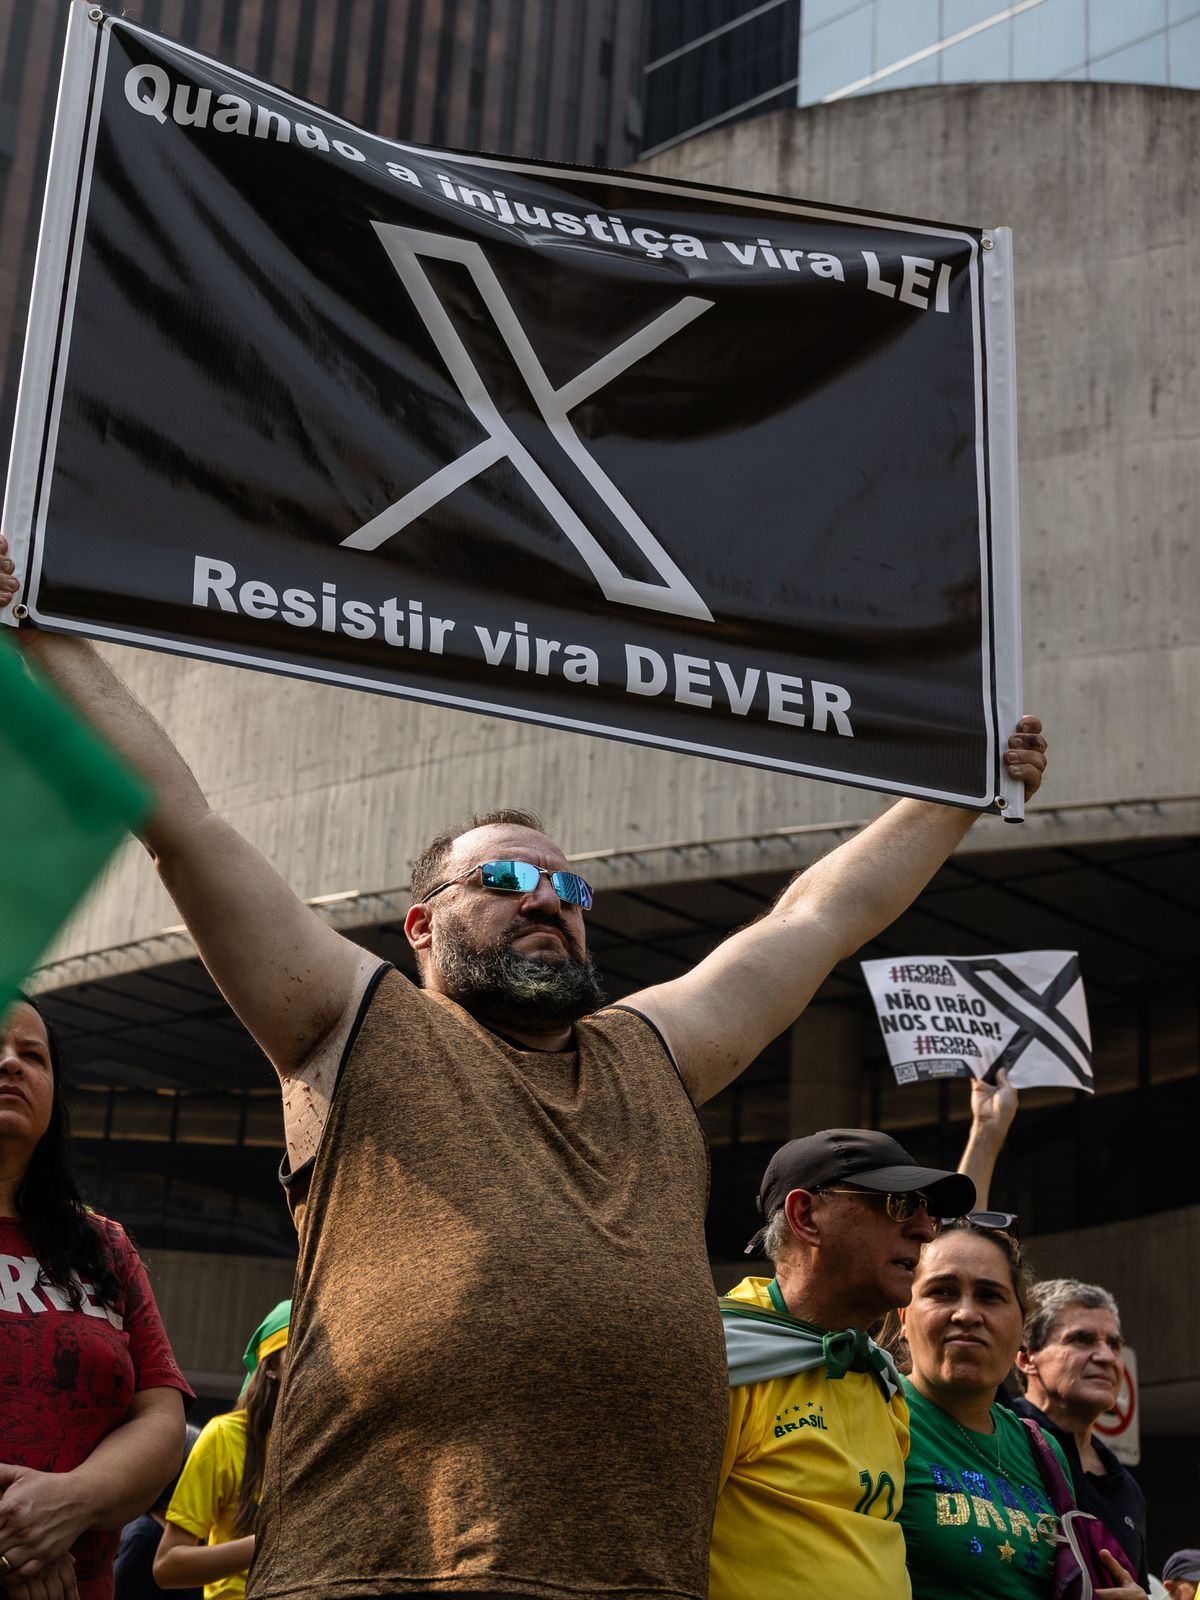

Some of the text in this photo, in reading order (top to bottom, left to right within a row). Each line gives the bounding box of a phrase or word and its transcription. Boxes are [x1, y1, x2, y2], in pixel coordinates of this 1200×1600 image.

[124, 64, 952, 313] Quando a injustiça vira LEI
[192, 555, 855, 738] Resistir vira DEVER
[889, 964, 953, 983] #FORA
[907, 975, 957, 987] MORAES
[884, 988, 987, 1017] NÃO IRÃO
[881, 1013, 1003, 1041] NOS CALAR!
[913, 1035, 980, 1056] #FORA
[774, 1413, 828, 1439] BRASIL
[854, 1469, 896, 1521] 10
